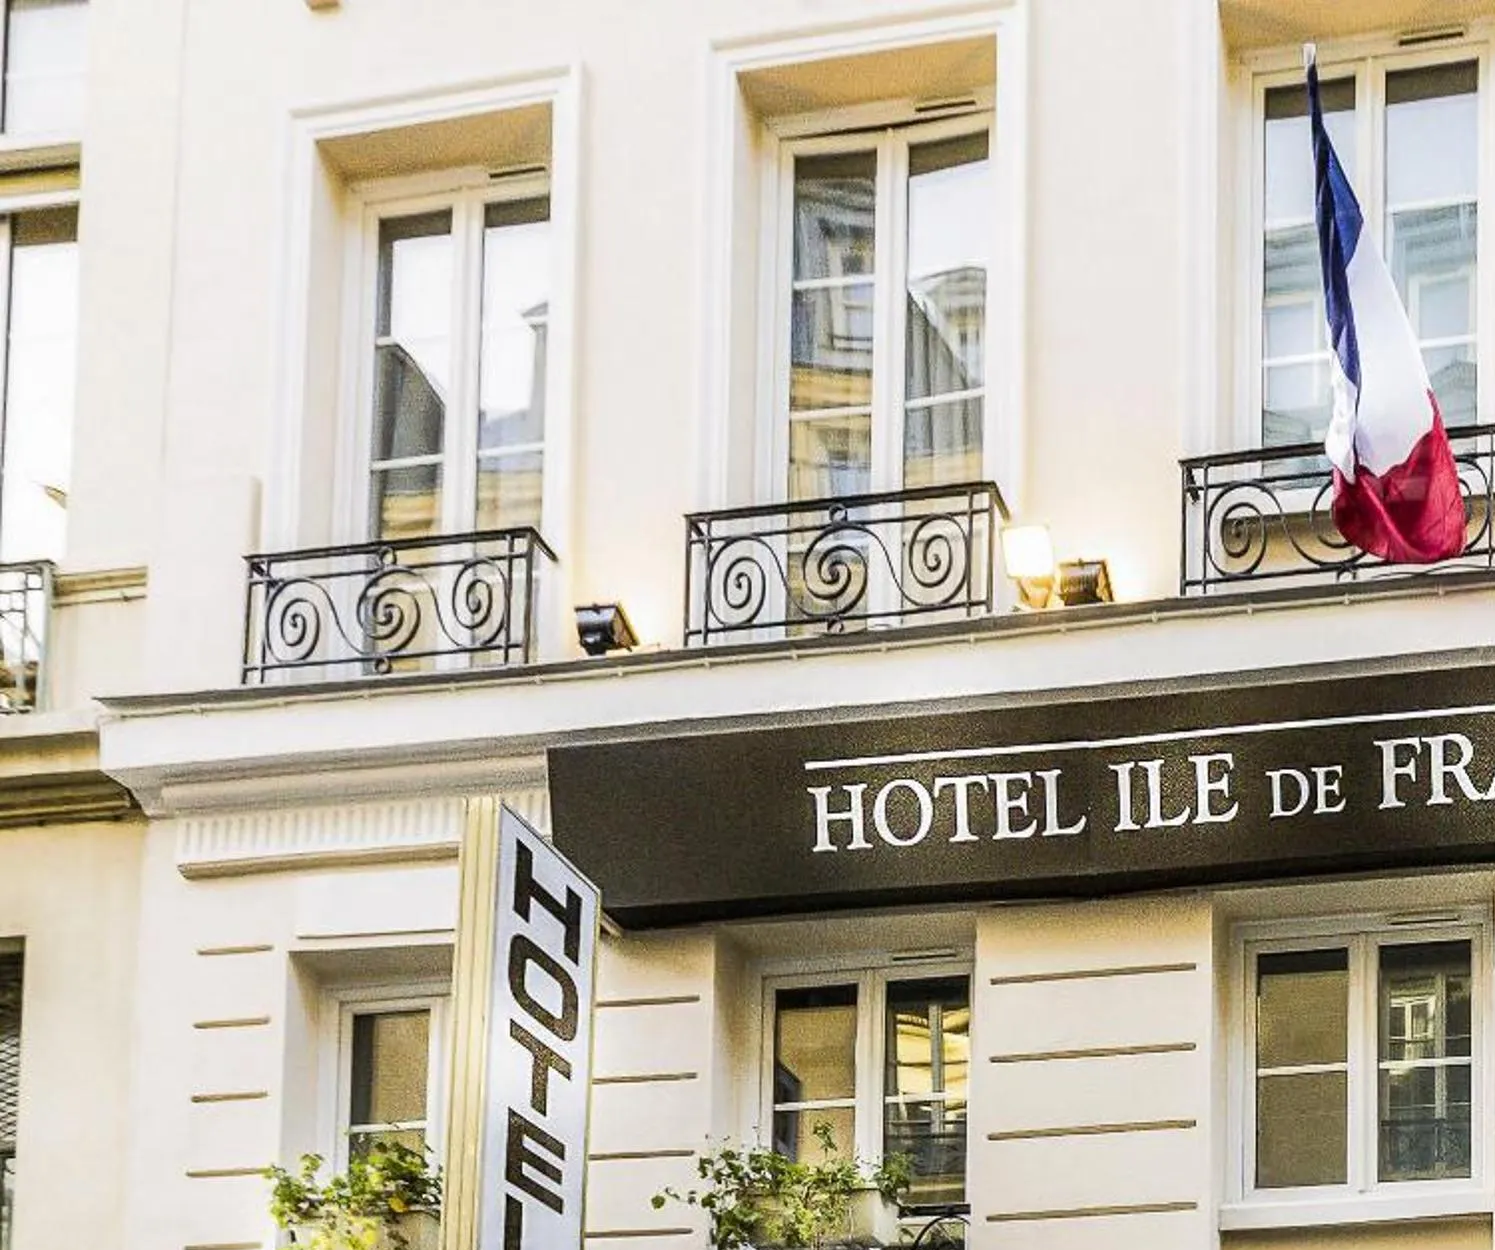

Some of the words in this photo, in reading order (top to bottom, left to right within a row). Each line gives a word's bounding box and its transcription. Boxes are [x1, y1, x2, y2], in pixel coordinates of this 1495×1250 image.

[806, 768, 1087, 853] HOTEL
[1108, 752, 1239, 832] ILE
[1265, 765, 1346, 818] DE
